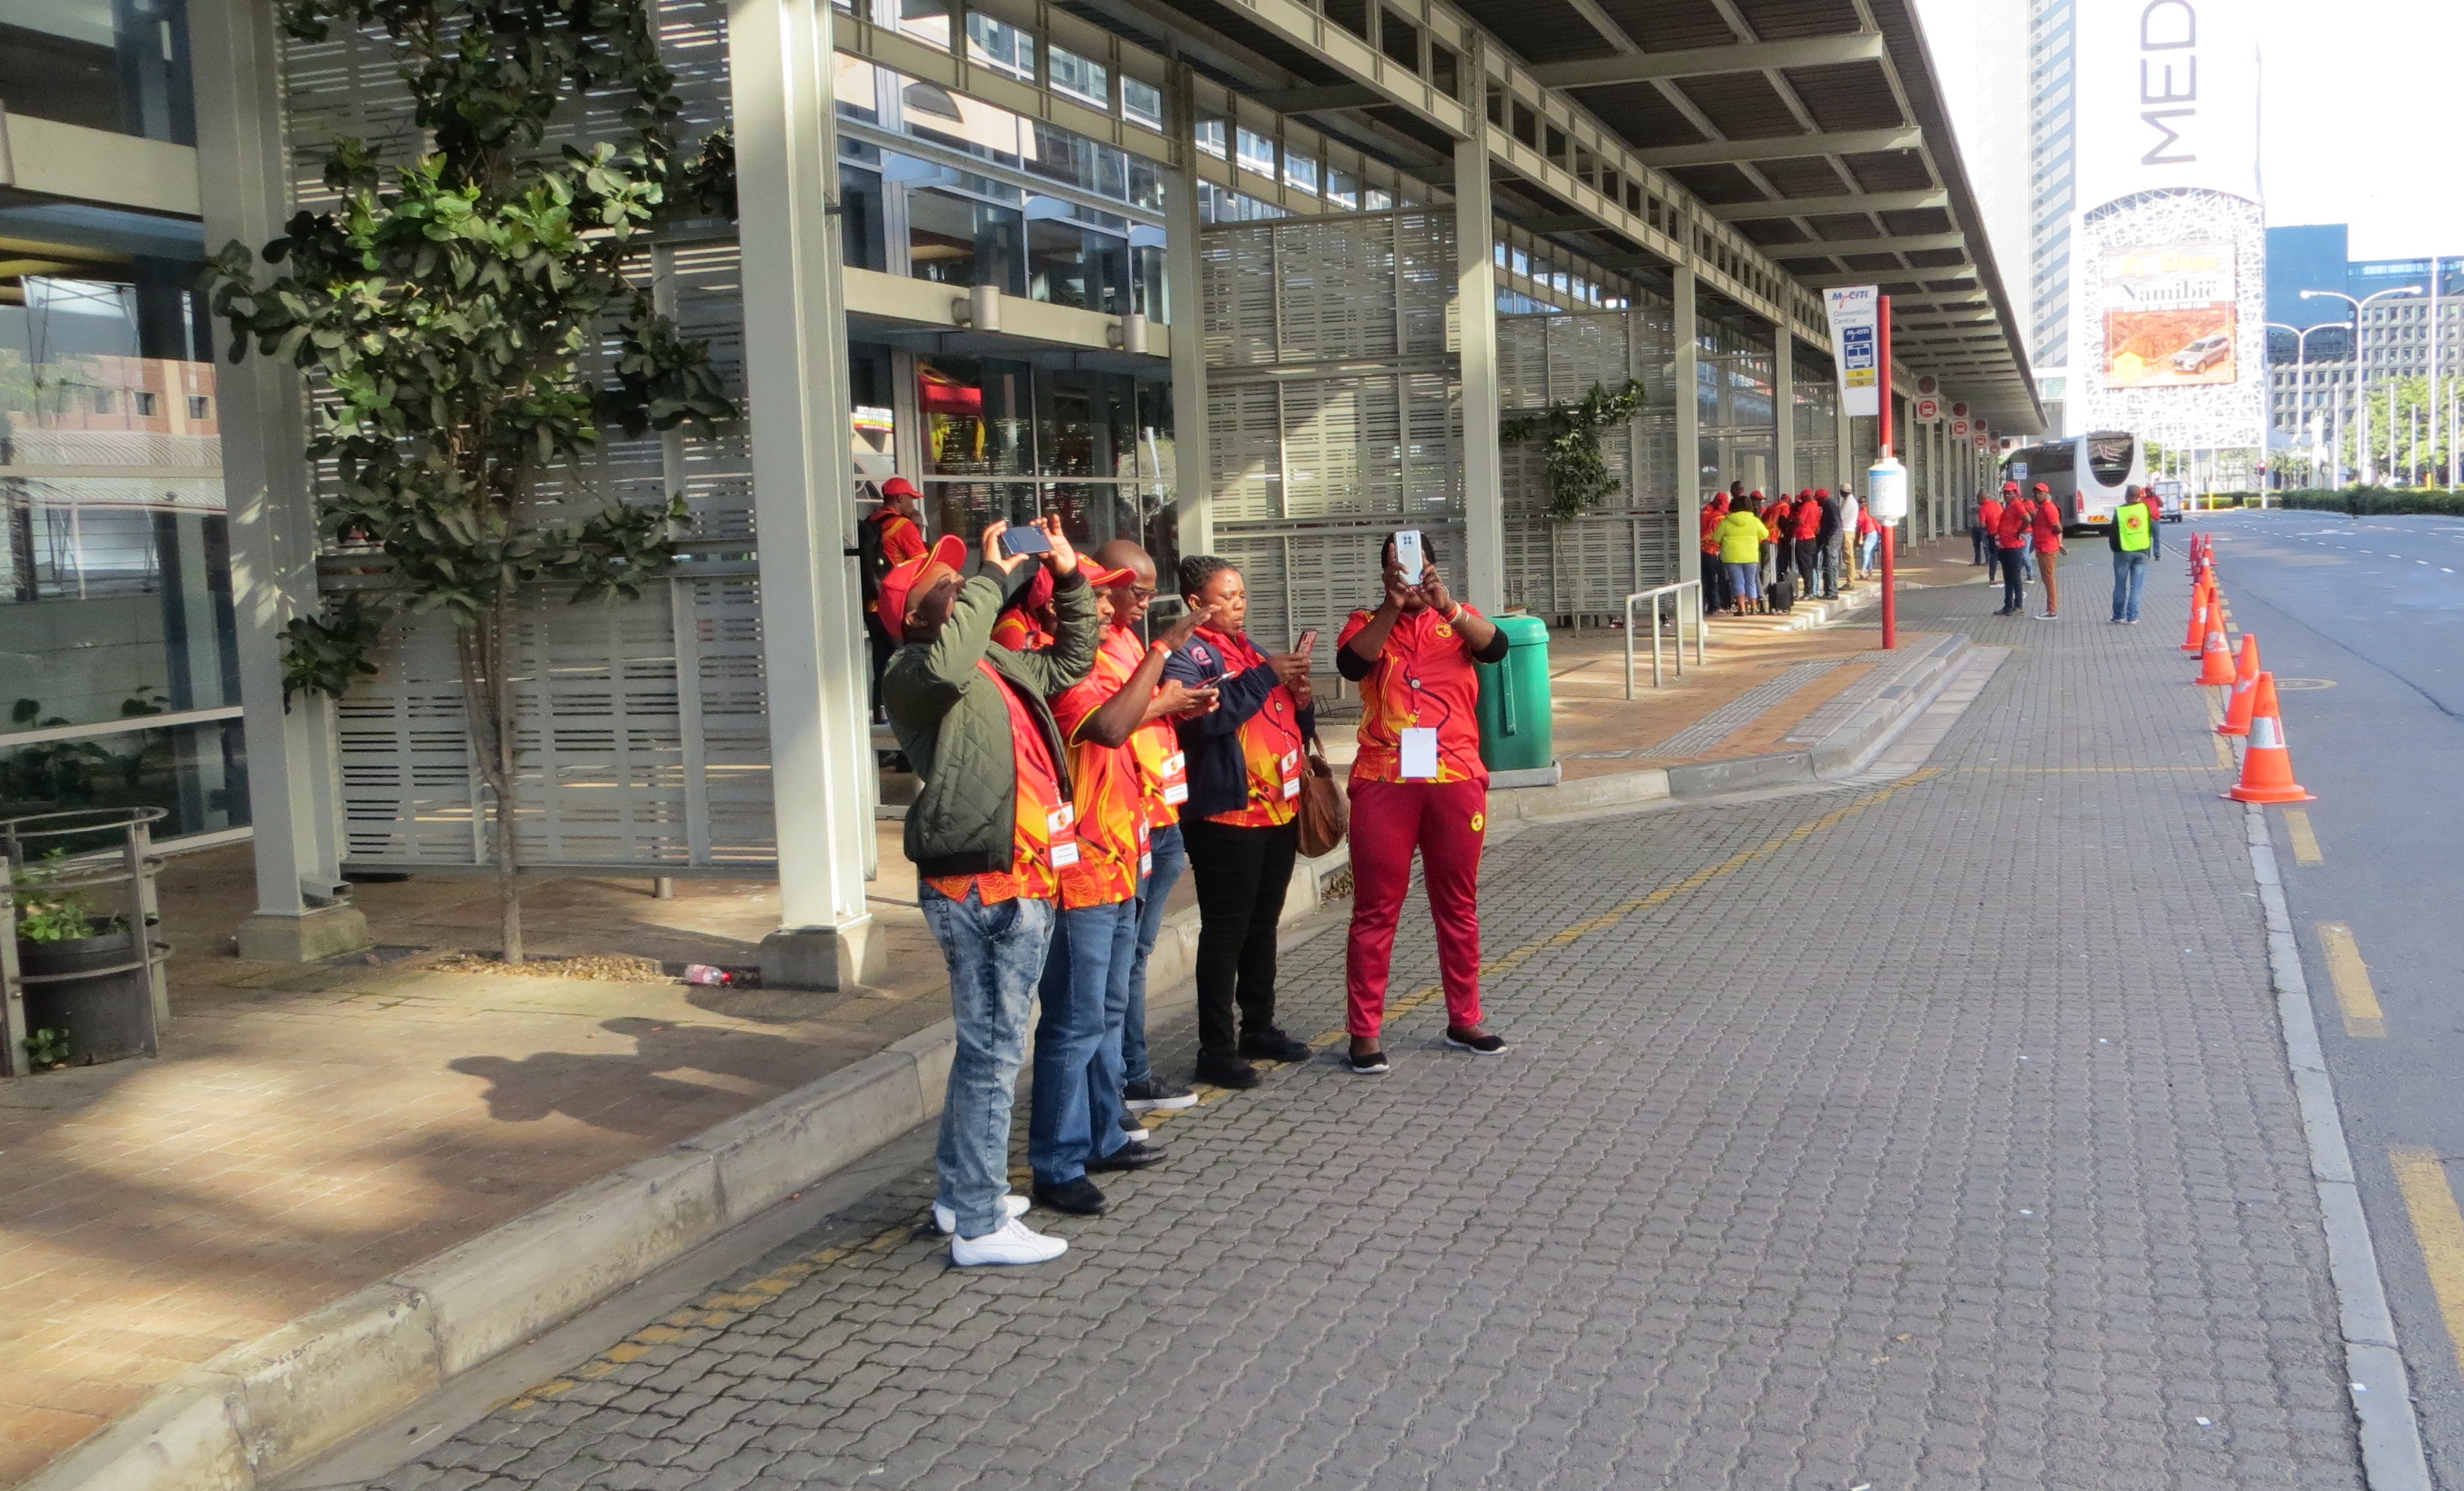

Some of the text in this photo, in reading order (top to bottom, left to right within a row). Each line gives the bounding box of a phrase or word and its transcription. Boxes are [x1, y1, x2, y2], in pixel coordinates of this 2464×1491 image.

[2141, 0, 2196, 166] MED
[2160, 253, 2219, 274] Sleep
[2121, 281, 2217, 302] Namibië
